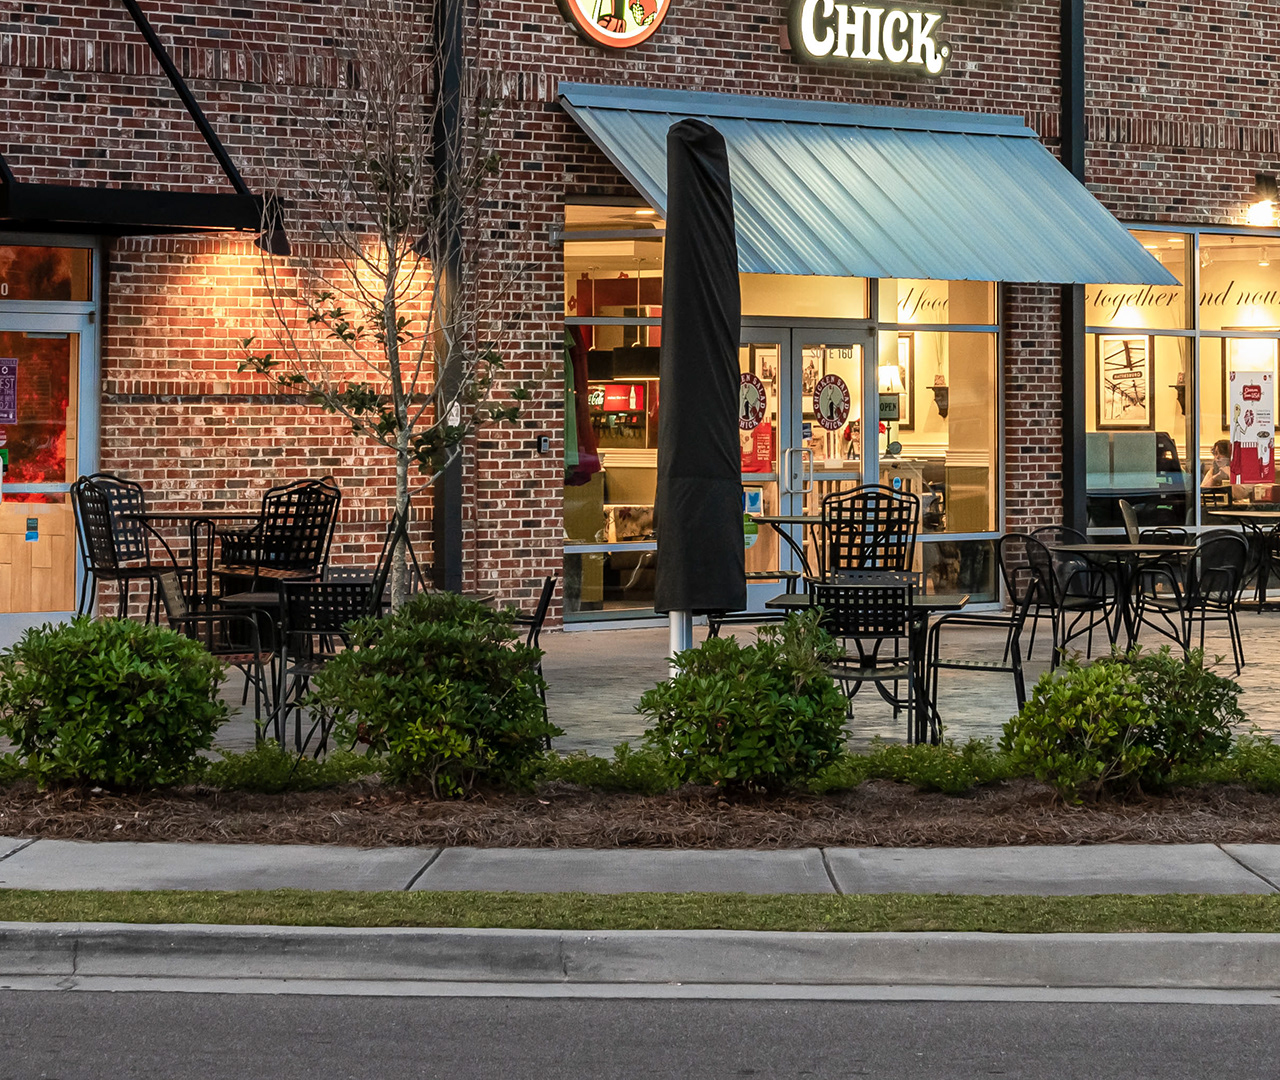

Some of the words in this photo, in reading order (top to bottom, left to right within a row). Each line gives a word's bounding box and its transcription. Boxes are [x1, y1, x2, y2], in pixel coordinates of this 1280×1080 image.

[1093, 284, 1179, 320] together
[880, 402, 897, 412] OPEN
[740, 419, 758, 429] HICK
